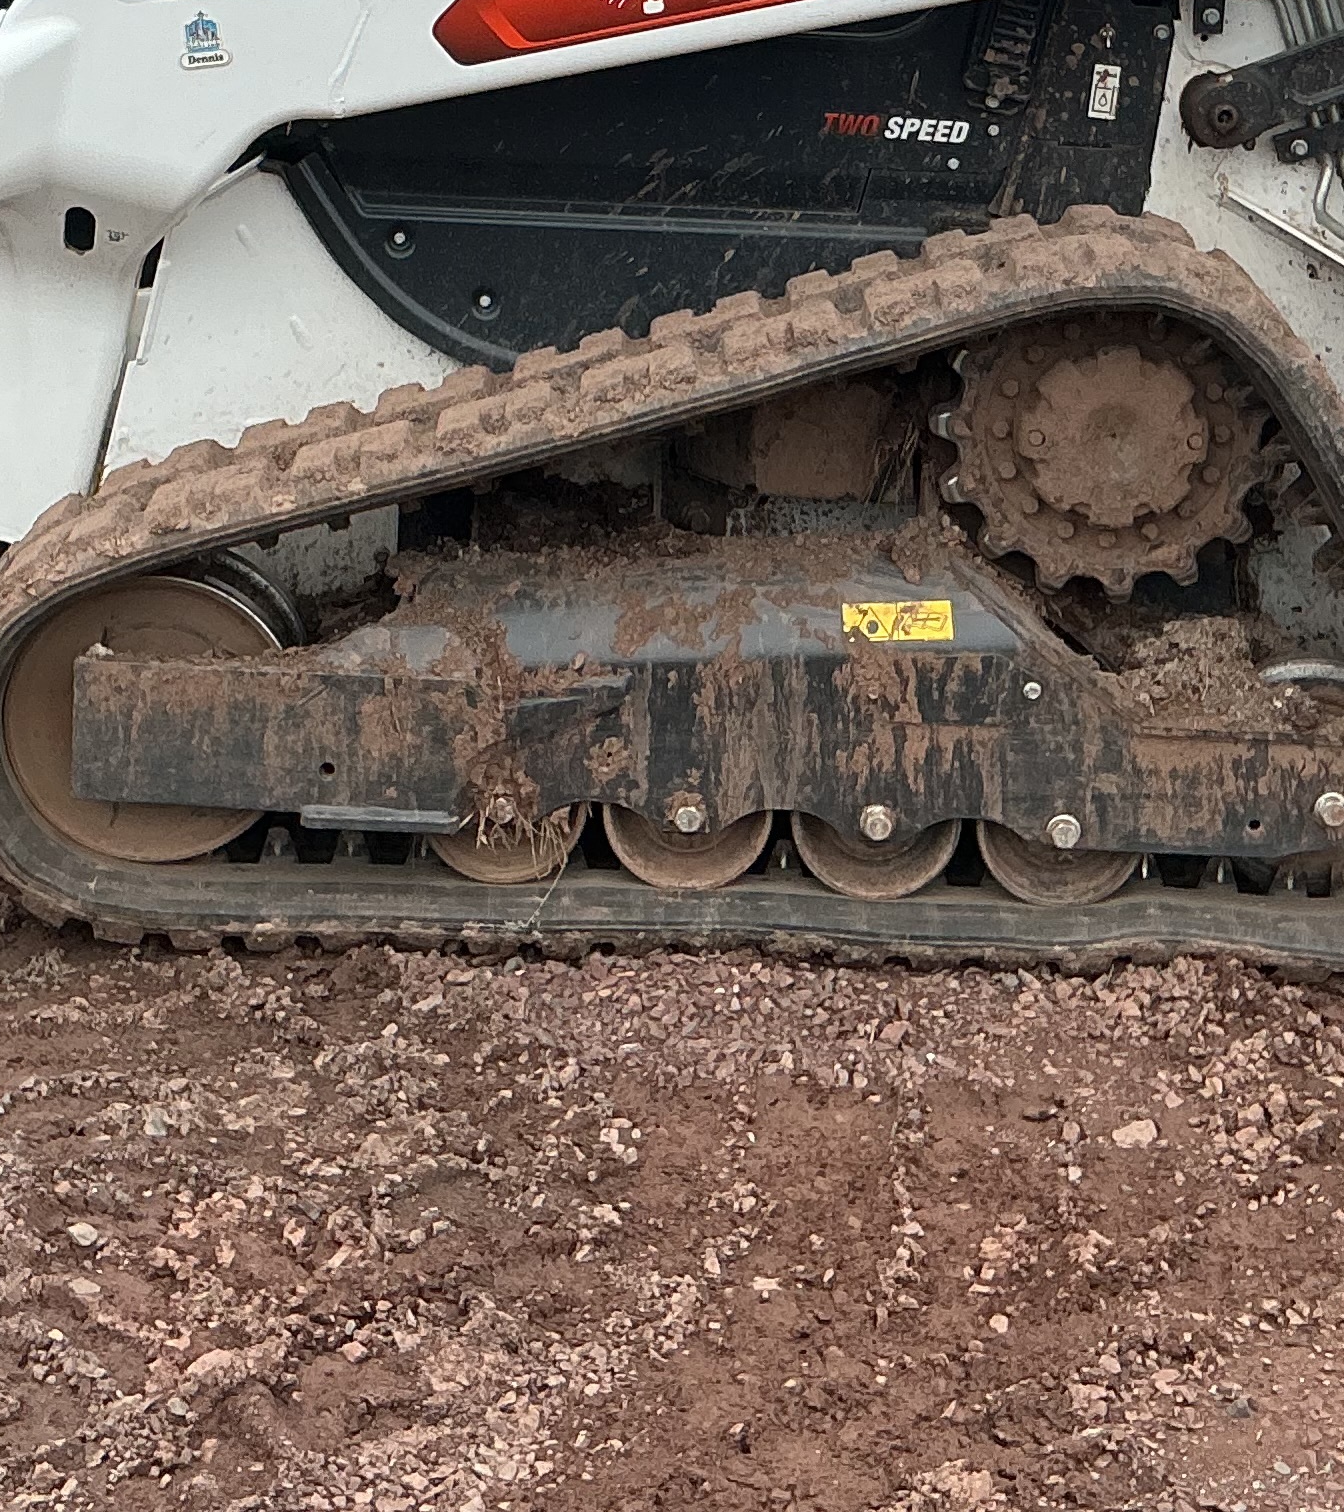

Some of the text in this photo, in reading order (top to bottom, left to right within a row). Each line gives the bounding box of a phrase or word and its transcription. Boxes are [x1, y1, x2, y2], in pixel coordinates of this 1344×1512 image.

[187, 53, 224, 65] Dennis
[819, 112, 970, 144] TWO SPEED
